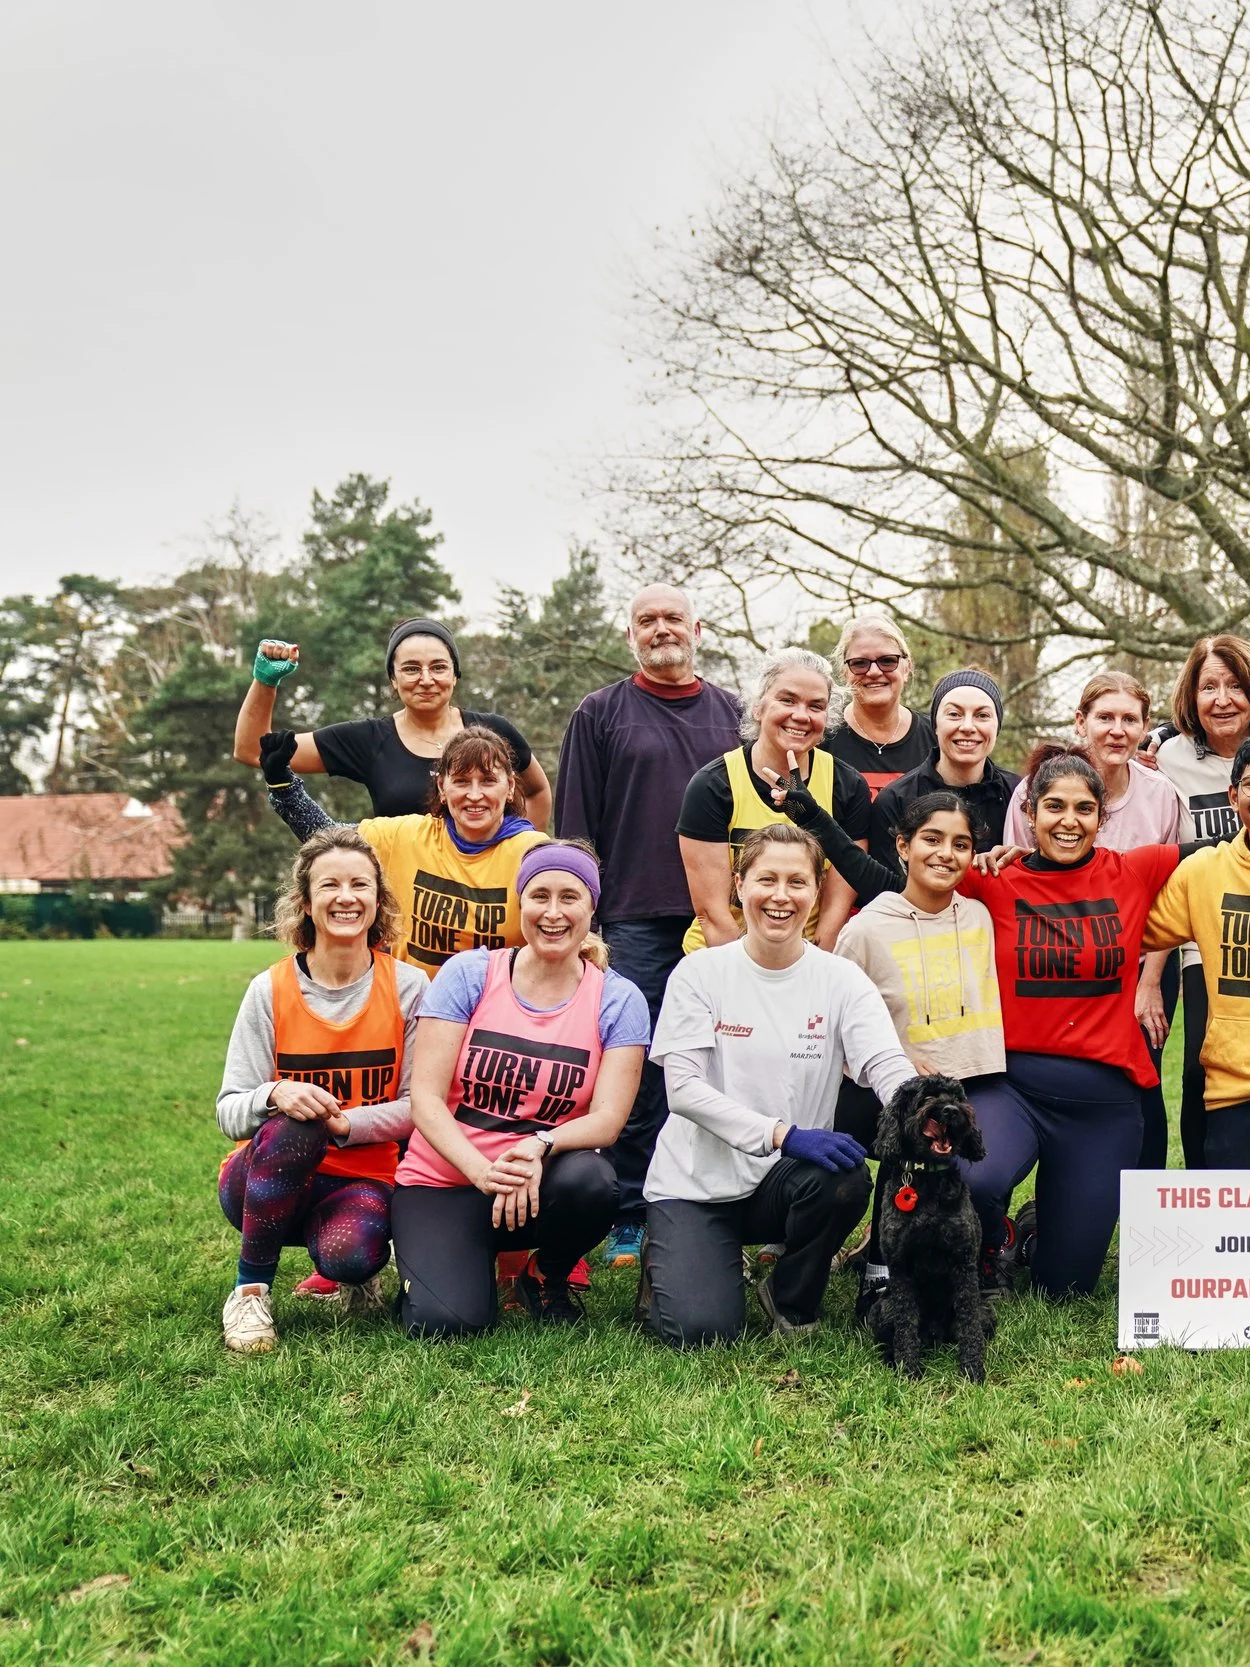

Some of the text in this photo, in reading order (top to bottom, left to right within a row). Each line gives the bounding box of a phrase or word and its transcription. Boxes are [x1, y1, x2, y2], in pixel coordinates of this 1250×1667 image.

[1191, 807, 1244, 838] TUR
[413, 886, 506, 934] TURN UP
[411, 914, 462, 952] TONE
[1016, 915, 1123, 948] TURN UP
[1014, 947, 1082, 979] TONE
[1095, 946, 1126, 979] UP
[361, 1067, 394, 1100] UP
[463, 1046, 586, 1099] TURN UP
[459, 1077, 577, 1124] TONE UP
[1157, 1187, 1211, 1209] THIS
[1134, 1318, 1150, 1326] TURN
